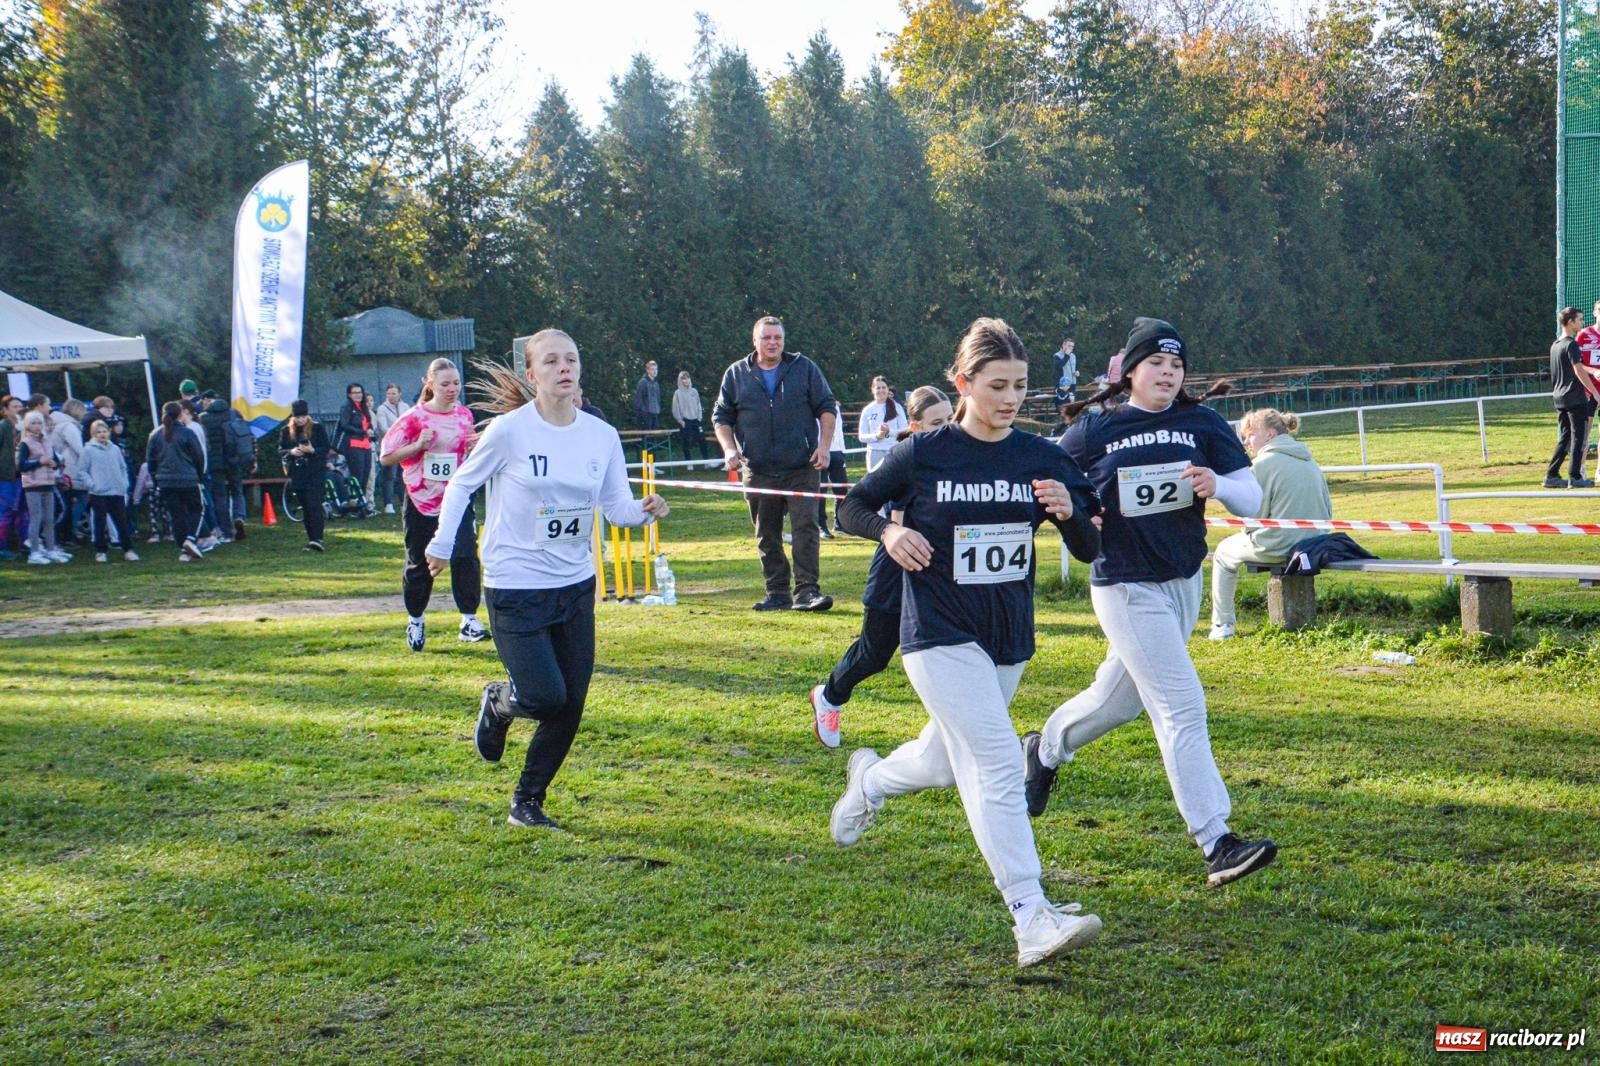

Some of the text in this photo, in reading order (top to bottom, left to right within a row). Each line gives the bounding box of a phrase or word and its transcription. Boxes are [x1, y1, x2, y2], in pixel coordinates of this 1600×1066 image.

[49, 345, 80, 360] JUTRA
[254, 342, 275, 377] LEPSZEGO
[253, 378, 272, 400] JUTRA
[431, 463, 450, 476] 88
[529, 454, 548, 477] 17
[1135, 482, 1178, 507] 92
[547, 517, 580, 539] 94
[961, 543, 1028, 573] 104
